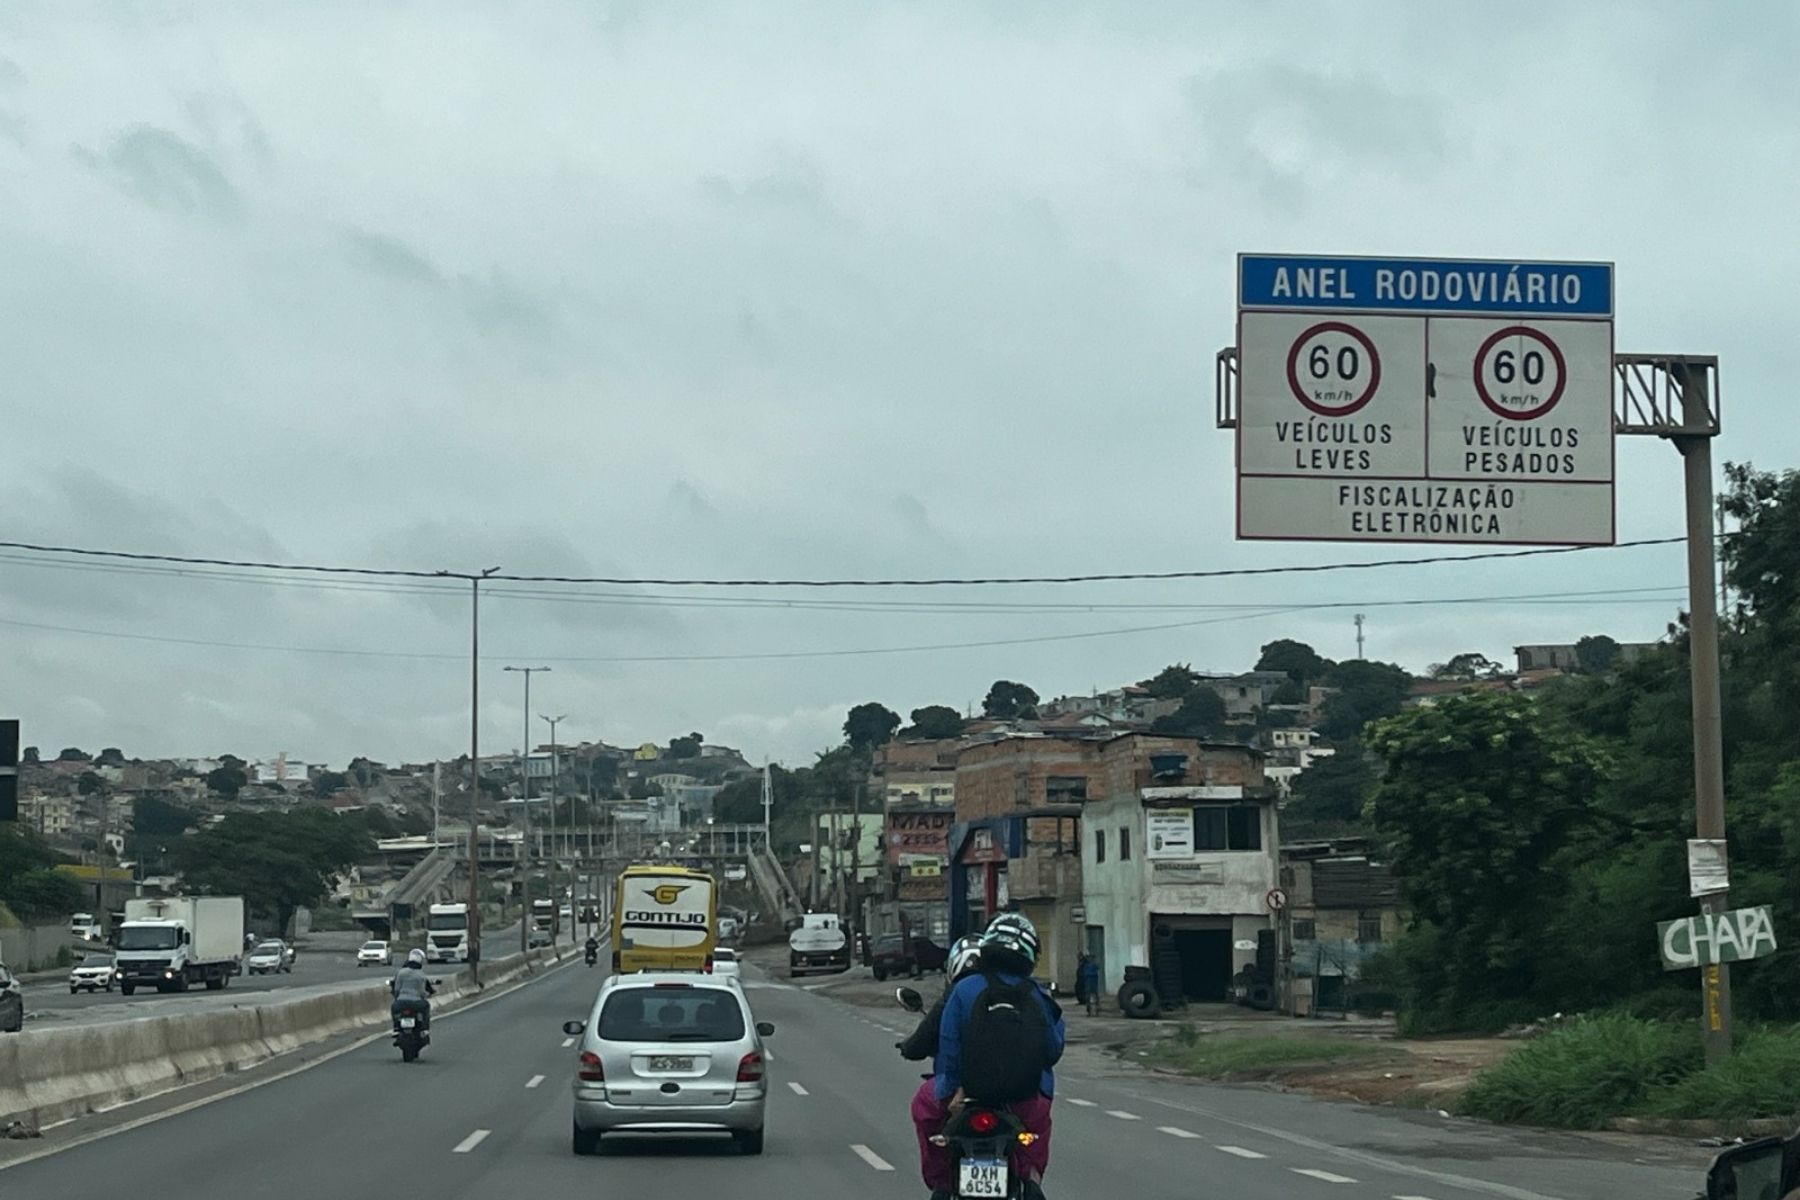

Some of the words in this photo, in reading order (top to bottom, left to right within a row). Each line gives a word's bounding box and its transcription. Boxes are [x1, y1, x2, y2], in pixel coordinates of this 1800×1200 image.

[1272, 266, 1355, 299] ANEL
[1376, 265, 1581, 304] RODOVIÁRIO
[1309, 345, 1359, 380] 60
[1494, 350, 1544, 385] 60
[1315, 390, 1353, 401] km/h
[1500, 394, 1539, 406] km/h
[1276, 415, 1392, 444] VEÍCULOS
[1462, 420, 1578, 448] VEÍCULOS
[1296, 448, 1370, 470] LEVES
[1465, 452, 1574, 474] PESADOS
[1339, 484, 1513, 511] FISCALIZAÇÃO
[1352, 508, 1500, 534] ELETRÔNICA
[625, 911, 706, 924] GONTIJO
[1663, 908, 1777, 967] CHAPA
[966, 1180, 1001, 1195] 6C54
